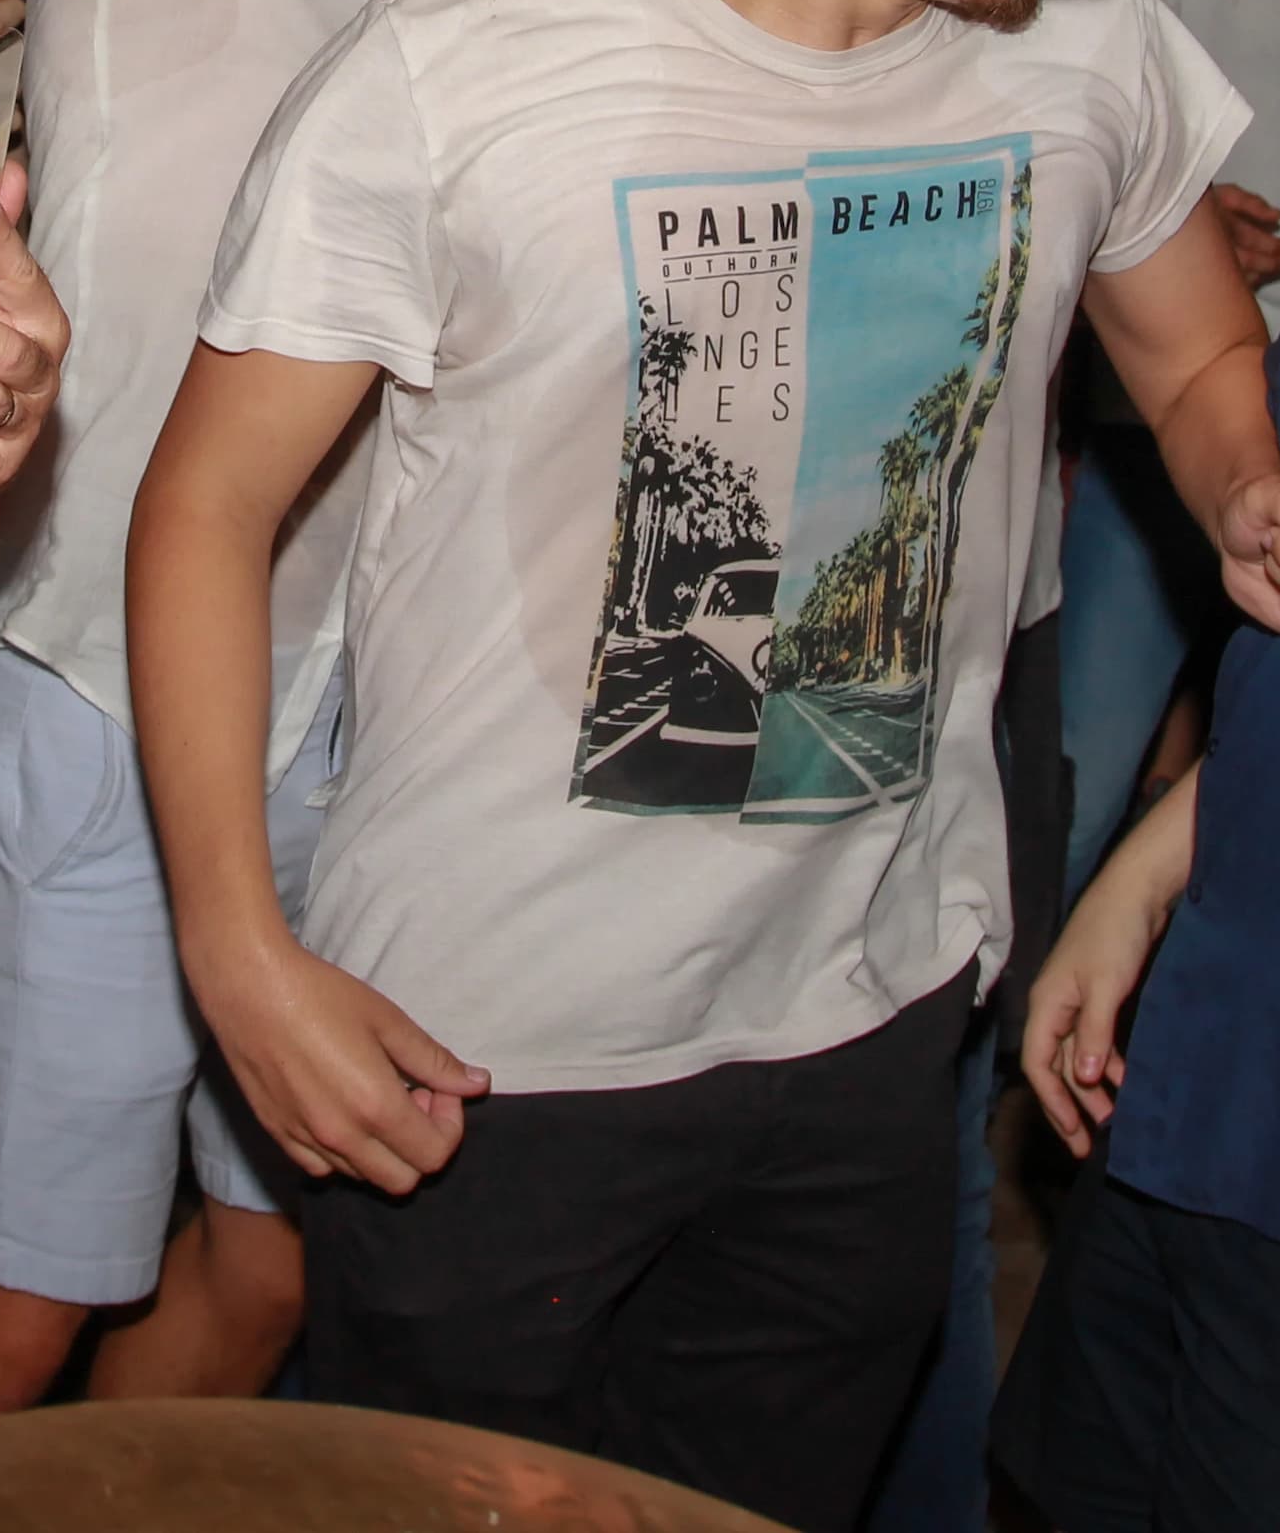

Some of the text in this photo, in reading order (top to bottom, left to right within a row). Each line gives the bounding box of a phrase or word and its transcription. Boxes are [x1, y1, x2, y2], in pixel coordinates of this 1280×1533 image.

[658, 180, 977, 252] PALM BEACH
[976, 178, 997, 216] 1978
[662, 251, 798, 278] OUTHORN
[665, 274, 794, 326] LOS
[665, 327, 791, 372] NGE
[662, 382, 791, 423] LES
